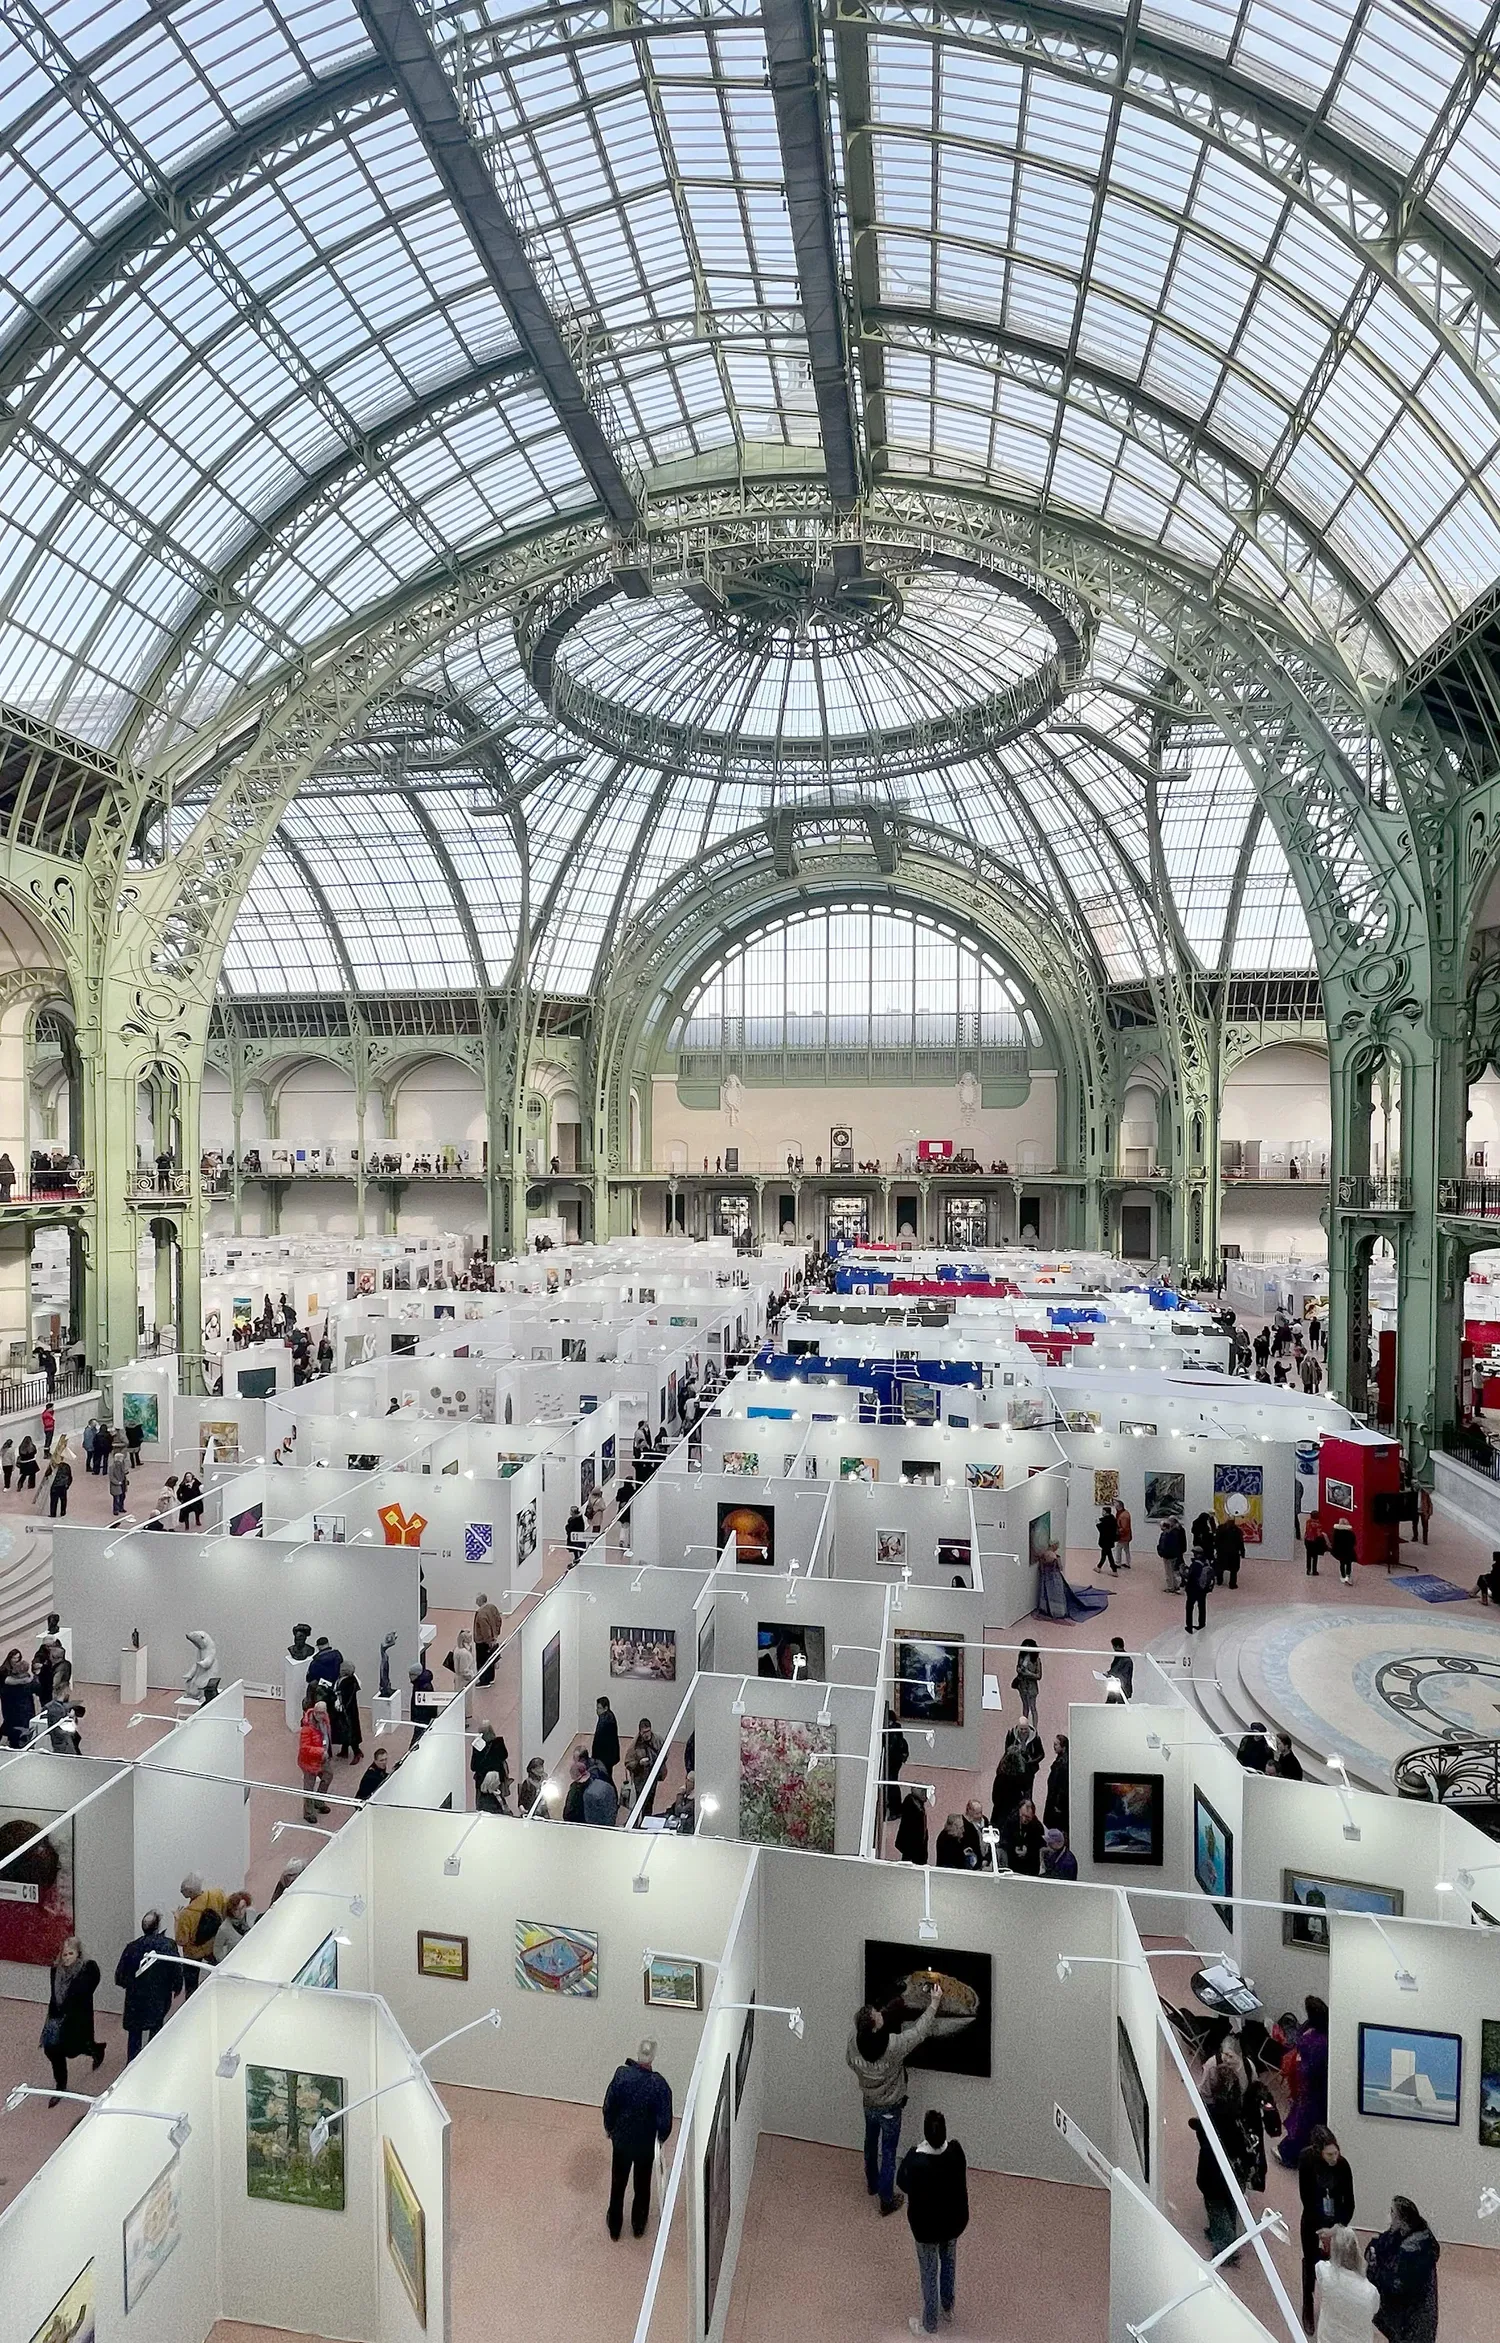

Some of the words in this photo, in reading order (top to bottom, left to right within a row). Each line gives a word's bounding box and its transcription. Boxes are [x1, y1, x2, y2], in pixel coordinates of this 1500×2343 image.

[1187, 1656, 1192, 1667] 3
[270, 1686, 274, 1696] C
[275, 1686, 282, 1697] 15
[417, 1693, 422, 1704] G
[422, 1693, 426, 1703] 4
[22, 1885, 28, 1899] C
[29, 1885, 37, 1900] 16
[1056, 2108, 1062, 2128] G
[1062, 2115, 1068, 2135] 5
